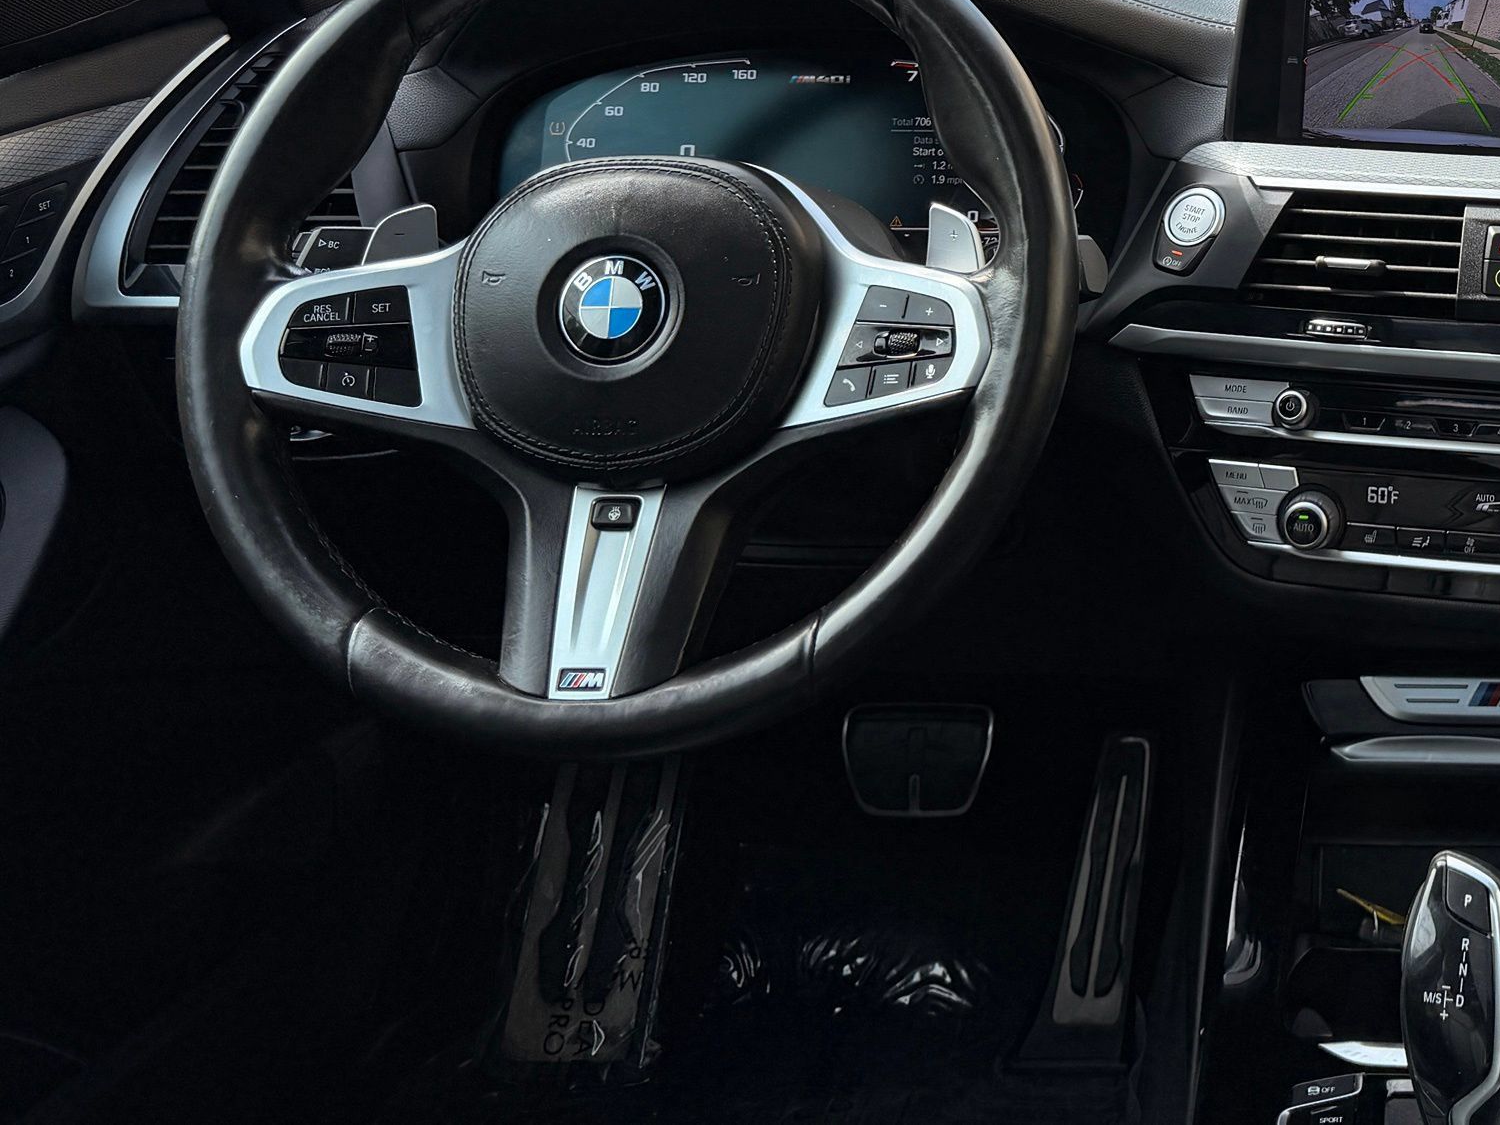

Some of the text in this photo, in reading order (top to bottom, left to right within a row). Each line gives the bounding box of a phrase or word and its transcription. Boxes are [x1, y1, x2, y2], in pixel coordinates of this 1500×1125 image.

[683, 72, 707, 83] 120
[732, 69, 757, 81] 160
[906, 70, 918, 82] 7
[640, 82, 660, 93] 80
[604, 106, 624, 117] 60
[891, 117, 914, 127] Total
[576, 137, 596, 148] 40
[913, 136, 934, 145] Data
[912, 147, 936, 157] Start
[932, 160, 947, 170] 1.2
[931, 174, 946, 185] 1.9
[38, 200, 51, 212] SET
[1184, 204, 1206, 216] START
[1182, 213, 1201, 223] STOP
[1175, 221, 1198, 234] ENGINE
[327, 240, 340, 250] BC
[1172, 259, 1183, 267] OFF
[573, 259, 656, 292] BMW
[313, 304, 332, 314] RES
[371, 303, 391, 313] SET
[303, 312, 341, 323] CANCEL
[1224, 384, 1247, 394] MODE
[1227, 406, 1249, 416] BAND
[1225, 470, 1247, 481] MENU
[1233, 497, 1252, 506] MAX
[1475, 493, 1495, 502] AUTO
[1293, 522, 1314, 533] AUTO
[1464, 545, 1476, 554] OFF
[1463, 894, 1473, 907] P
[1461, 937, 1469, 951] R
[1458, 963, 1468, 976] N
[1423, 991, 1465, 1008] M/S D
[1321, 1086, 1336, 1094] OFF
[1319, 1116, 1343, 1124] SPORT
